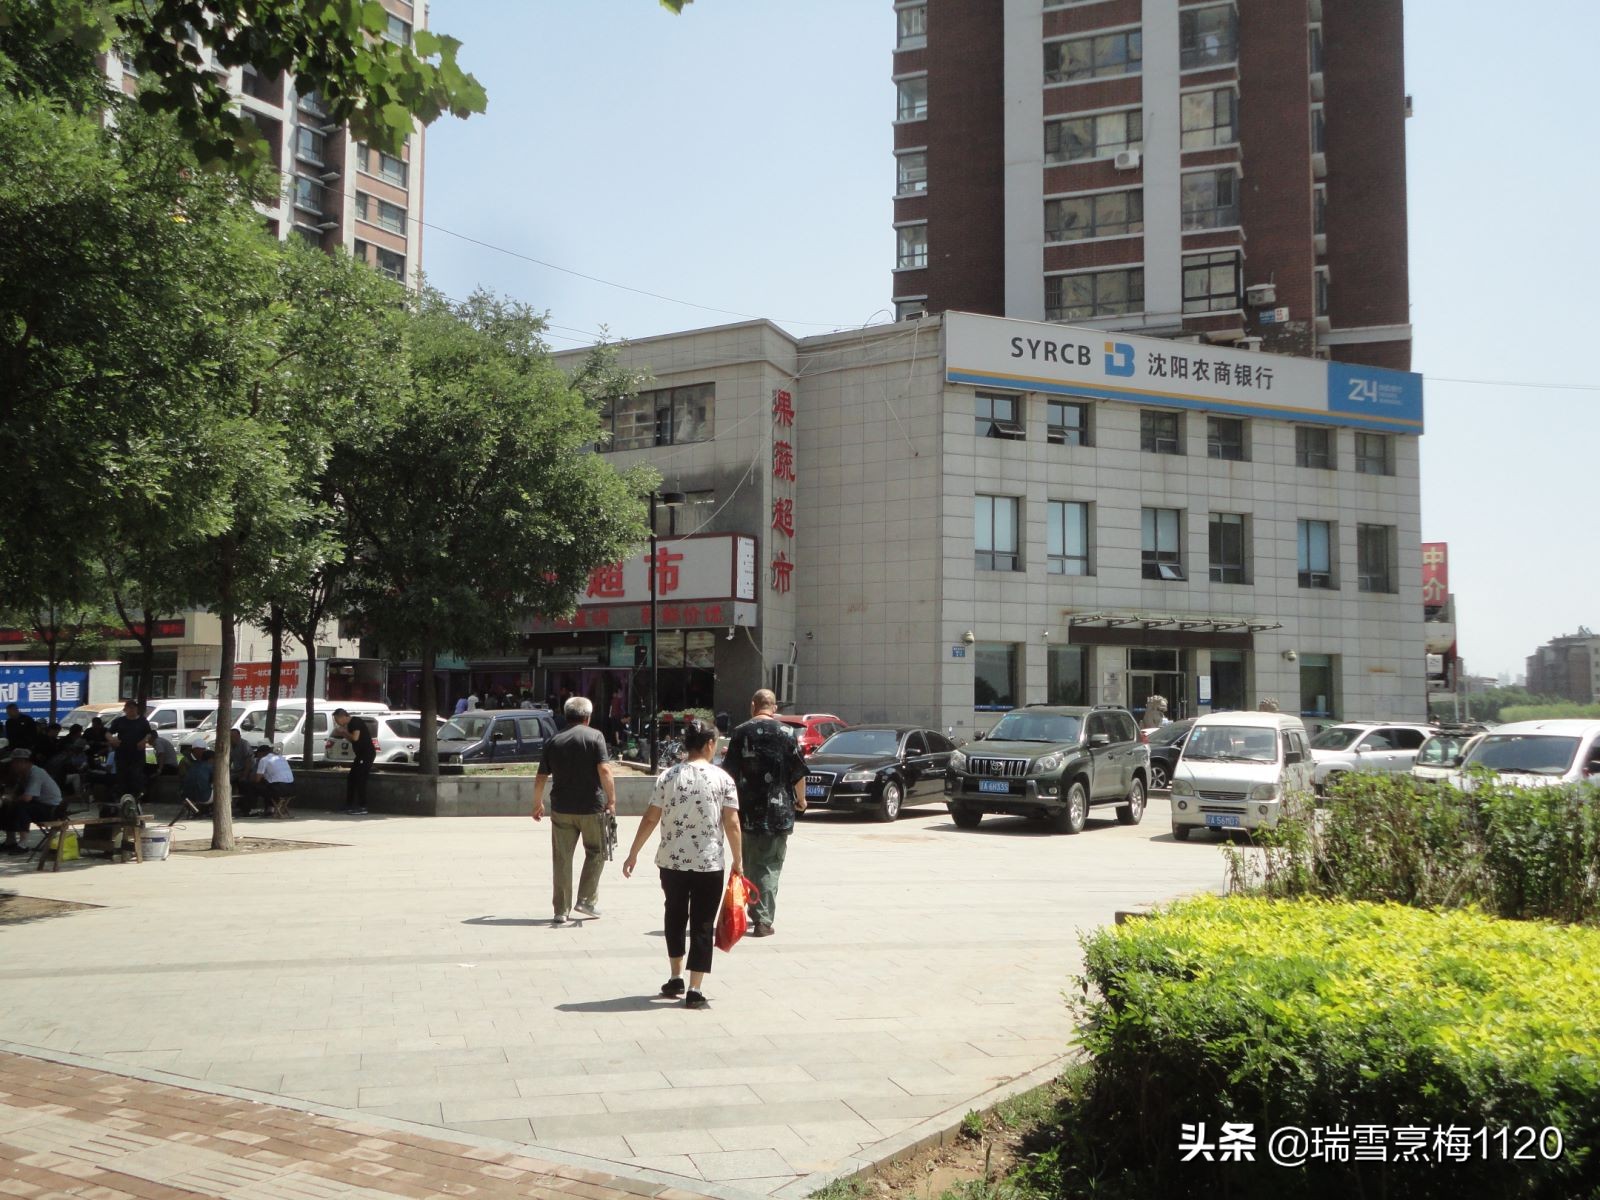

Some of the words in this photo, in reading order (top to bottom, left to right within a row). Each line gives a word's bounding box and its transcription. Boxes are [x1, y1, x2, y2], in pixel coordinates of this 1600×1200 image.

[1011, 336, 1091, 366] SYRCB
[1148, 352, 1274, 390] 沈阳农商银行
[1347, 378, 1377, 403] 24
[772, 389, 796, 595] 果蔬超市
[1422, 546, 1446, 602] 中介
